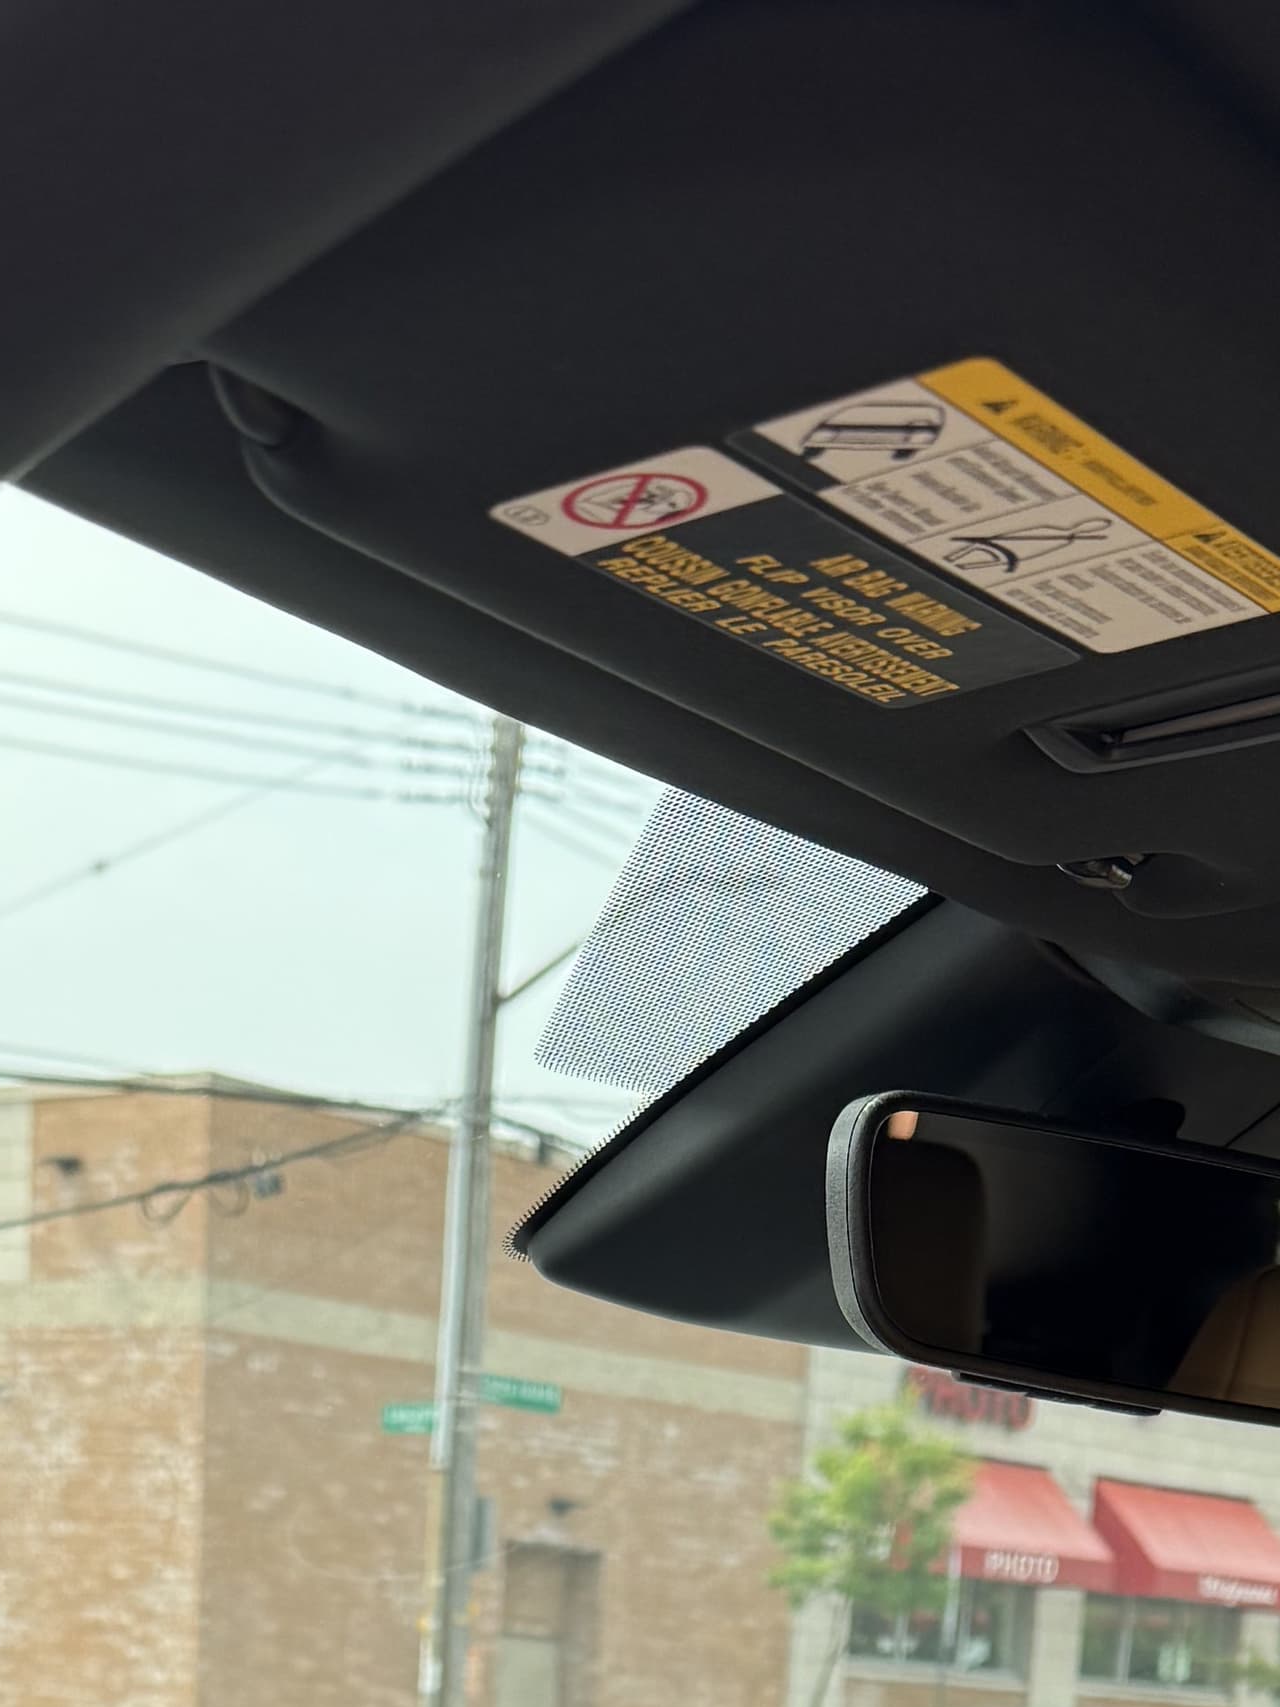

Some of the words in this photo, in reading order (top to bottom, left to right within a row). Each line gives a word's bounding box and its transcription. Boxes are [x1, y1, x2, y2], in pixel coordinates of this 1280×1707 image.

[598, 556, 721, 613] REPLIER
[715, 615, 767, 635] LE
[763, 638, 907, 703] PARESOLEIL
[622, 536, 731, 586] COUSSIN
[705, 579, 834, 637] GONFLABLE
[811, 631, 961, 697] AVERTISSEMENT
[736, 554, 810, 585] FLIP
[801, 587, 886, 627] VISOR
[875, 626, 953, 660] OVER
[810, 553, 869, 577] AIR
[842, 570, 908, 598] BAG
[884, 591, 982, 637] WARNING
